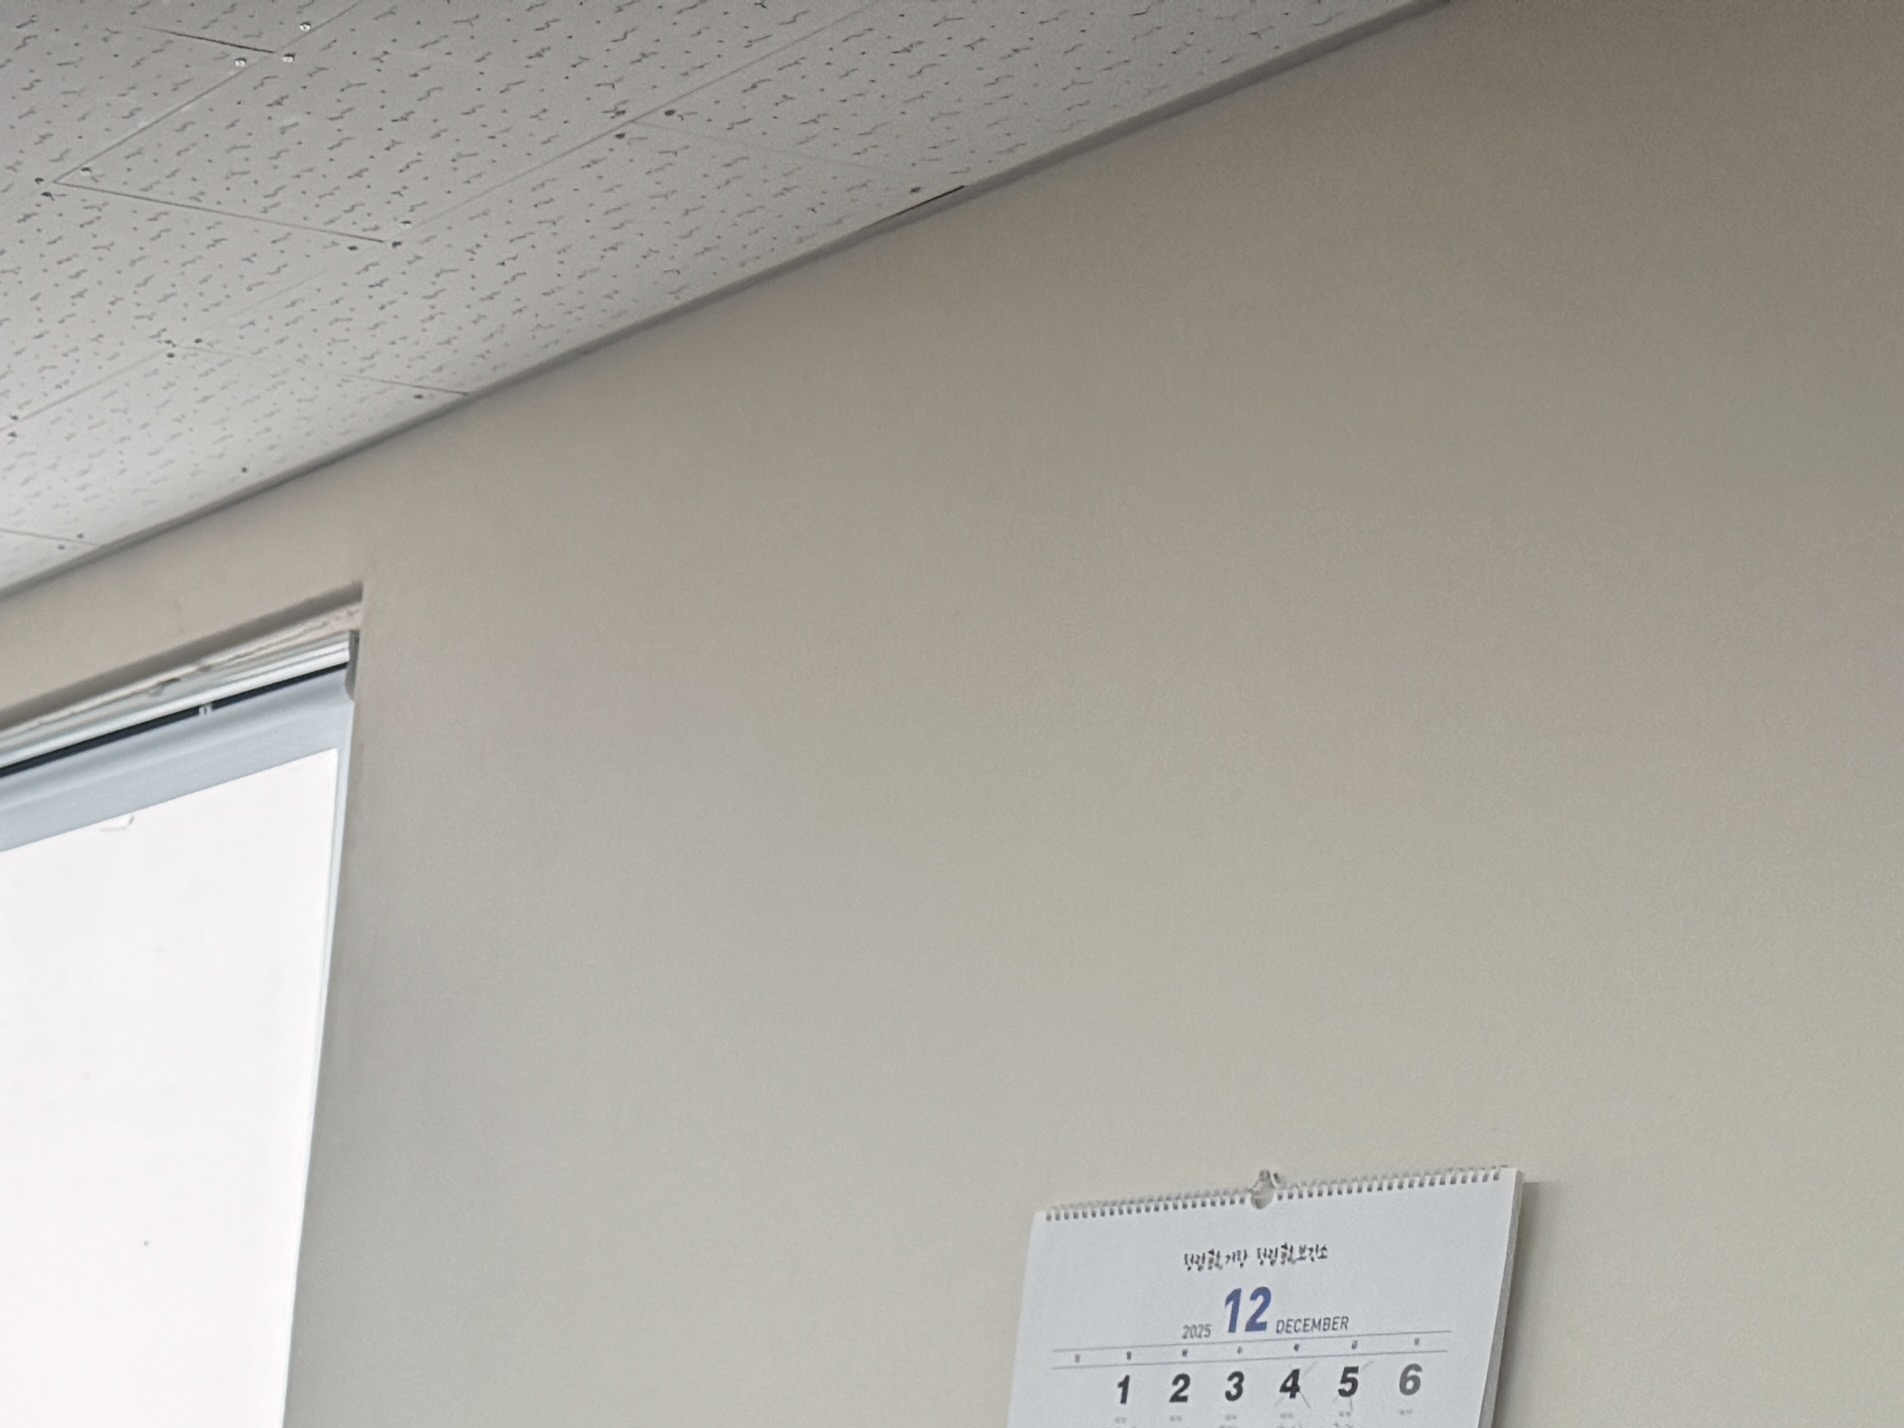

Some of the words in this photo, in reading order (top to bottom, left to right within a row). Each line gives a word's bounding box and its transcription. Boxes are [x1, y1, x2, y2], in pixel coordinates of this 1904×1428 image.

[1182, 1323, 1212, 1339] 2025
[1224, 1286, 1272, 1333] 12
[1276, 1316, 1349, 1334] DECEMBER
[1118, 1375, 1129, 1404] 1
[1170, 1374, 1190, 1402] 2
[1225, 1371, 1244, 1401] 3
[1280, 1369, 1300, 1398] 4
[1338, 1366, 1359, 1397] 5
[1399, 1364, 1422, 1395] 6
